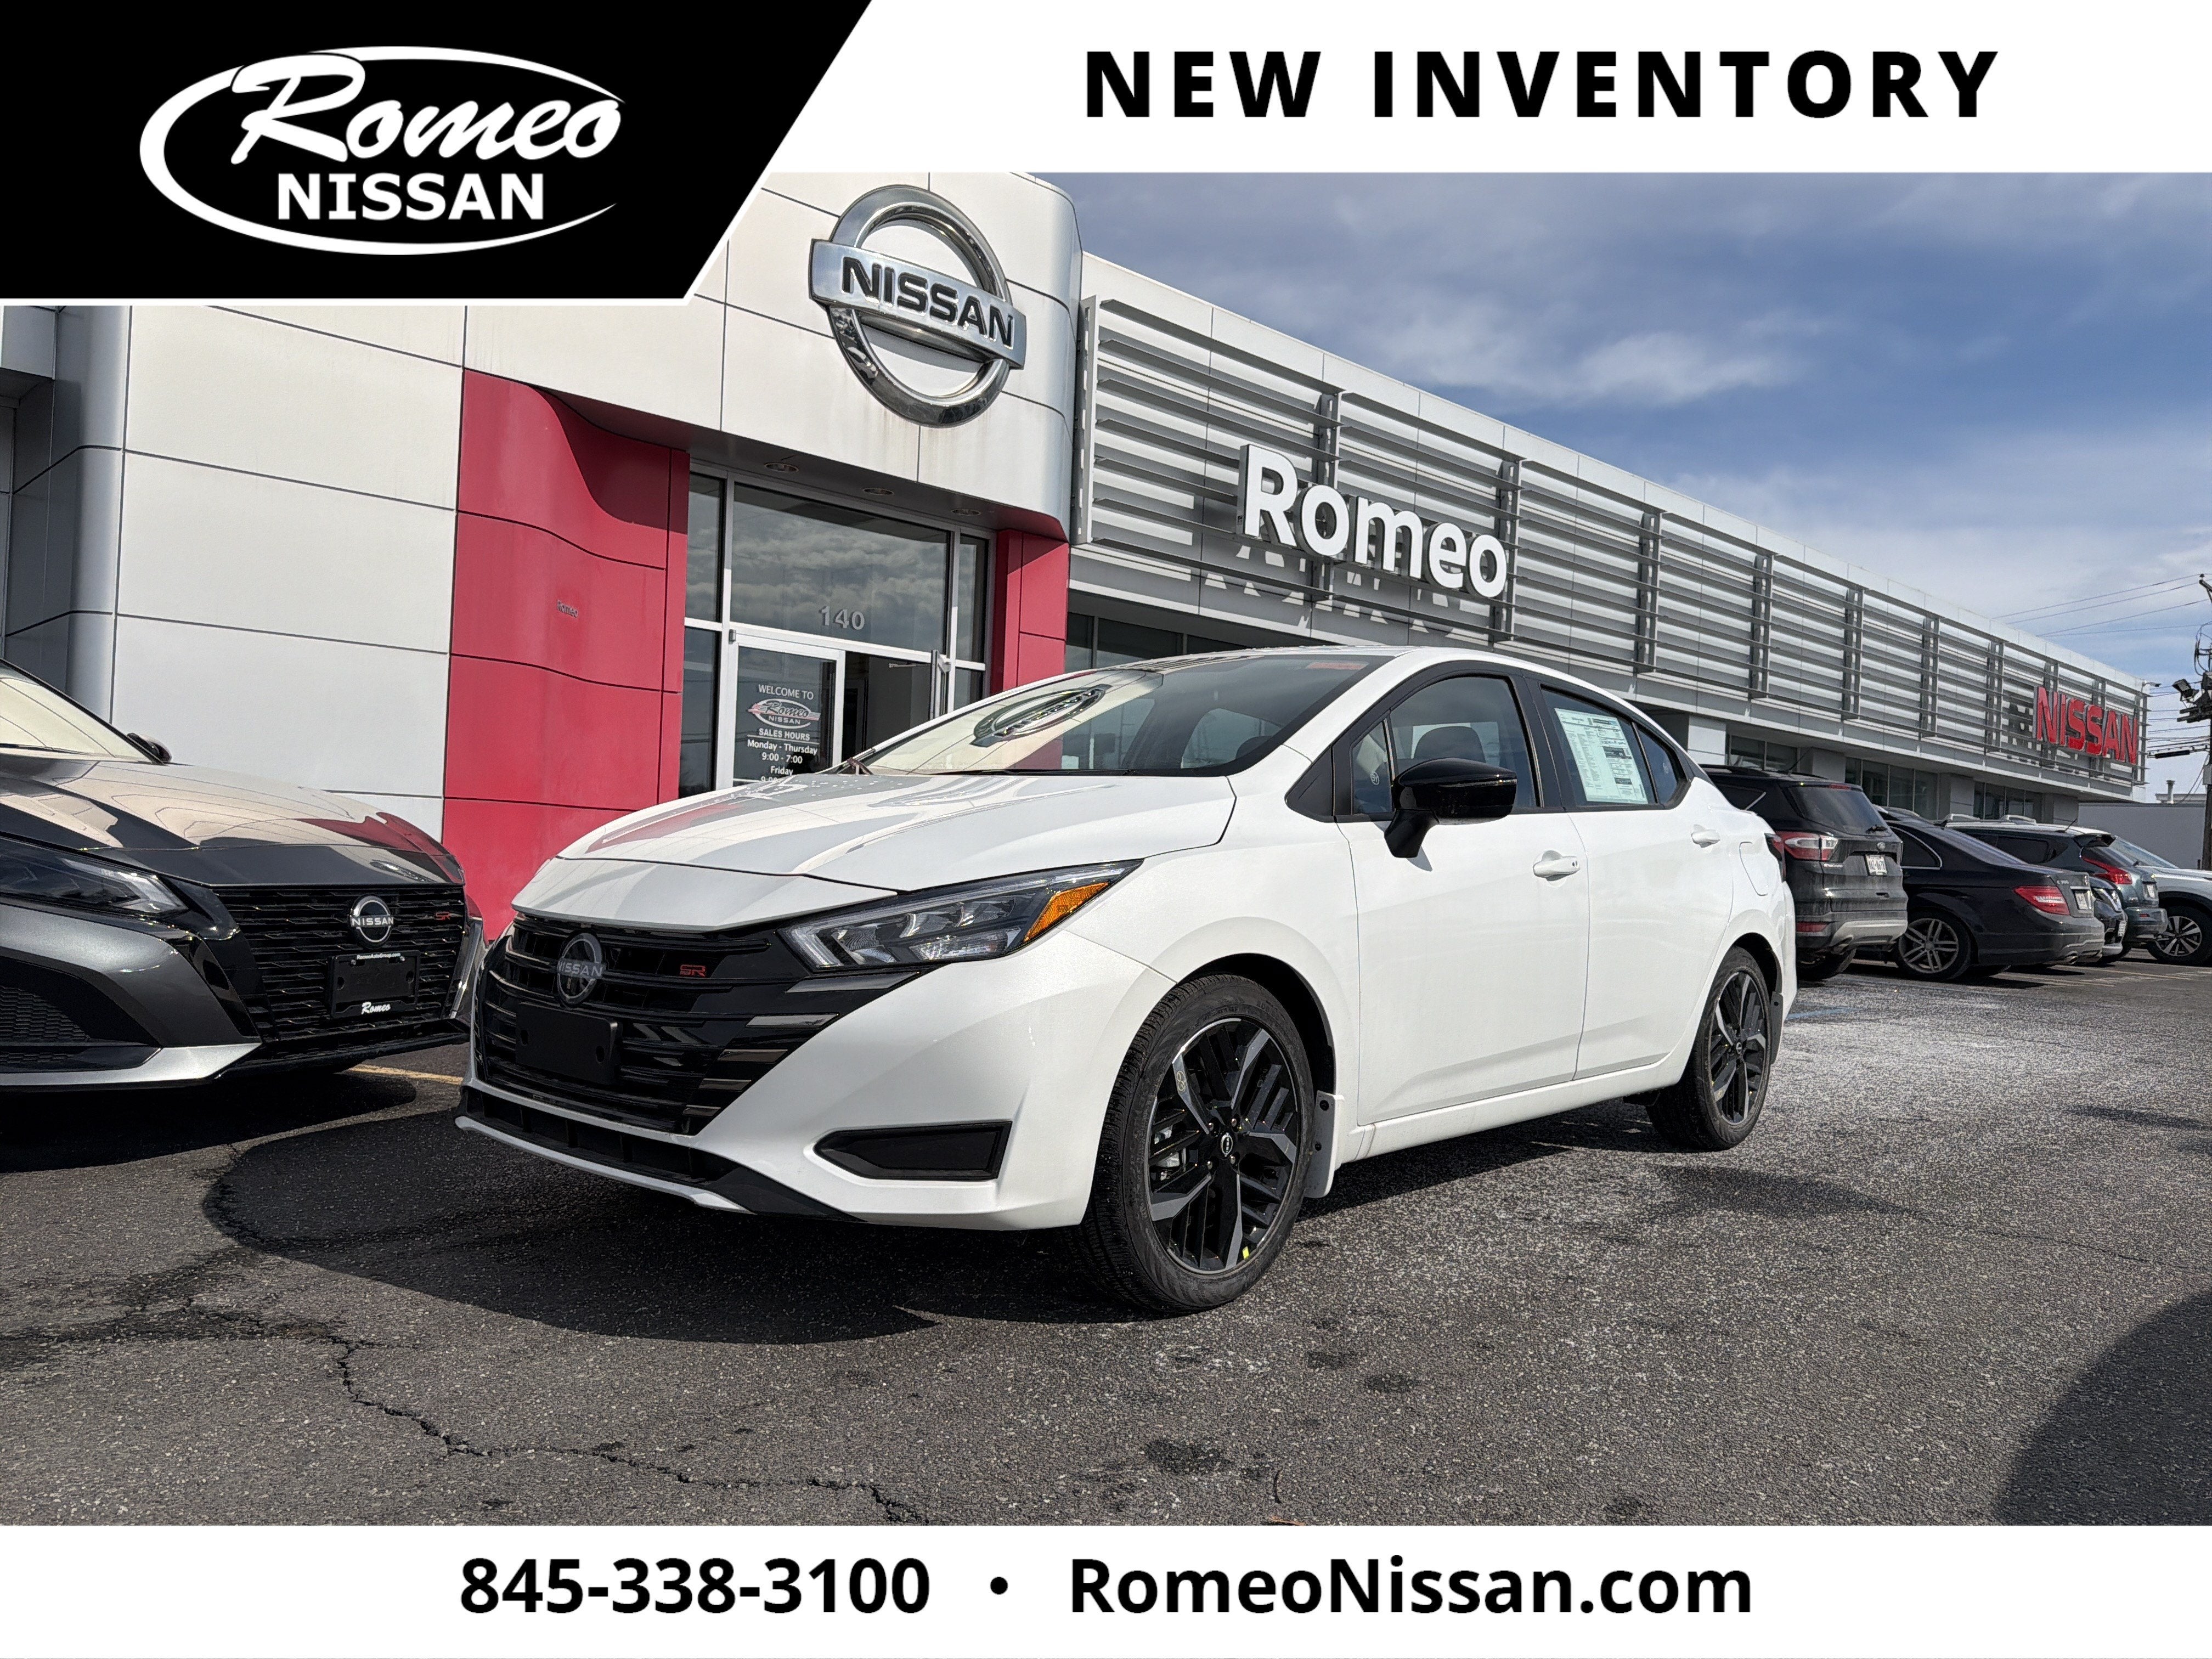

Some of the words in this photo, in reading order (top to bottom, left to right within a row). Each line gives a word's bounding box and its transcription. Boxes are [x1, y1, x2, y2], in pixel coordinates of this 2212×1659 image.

[841, 256, 1014, 350] NISSAN
[1240, 443, 1508, 599] Romeo
[821, 605, 865, 630] 140
[758, 684, 800, 698] WELCOME
[801, 690, 814, 700] TO
[762, 702, 809, 718] Romeo
[769, 715, 800, 725] NISSAN
[2036, 686, 2138, 766] NISSAN
[758, 727, 783, 738] SALES
[784, 731, 810, 741] HOURS
[747, 739, 778, 752] Monday
[784, 743, 818, 756] Thursday
[761, 752, 779, 761] 9:00
[786, 754, 803, 764] 7:00
[770, 765, 794, 776] Friday
[351, 917, 394, 926] NISSAN
[435, 911, 450, 921] SR
[557, 961, 603, 977] NISSAN
[680, 964, 708, 978] SR
[361, 1001, 391, 1015] Romeo
